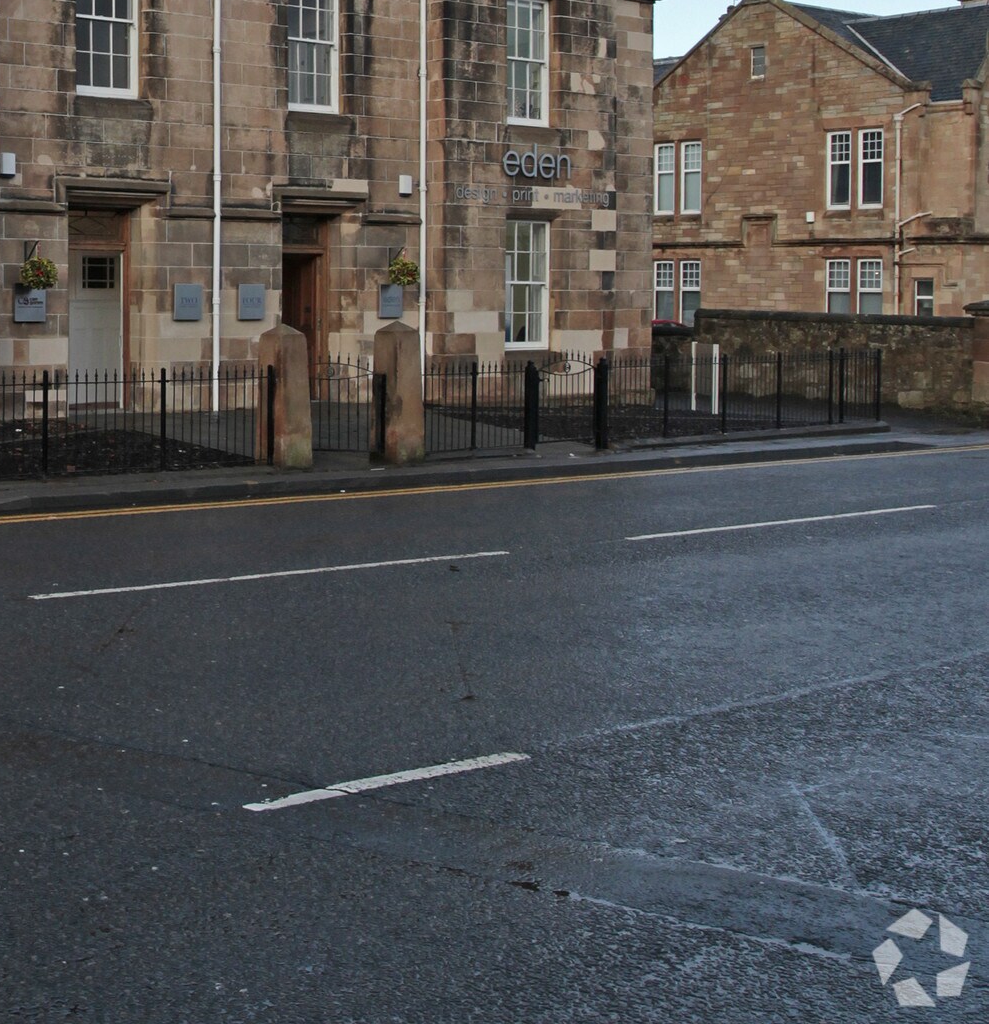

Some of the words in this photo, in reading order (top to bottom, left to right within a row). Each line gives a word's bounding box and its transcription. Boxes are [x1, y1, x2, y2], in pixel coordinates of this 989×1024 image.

[503, 143, 572, 179] eden
[455, 184, 498, 204] design
[512, 186, 539, 204] print
[553, 187, 610, 207] marketing
